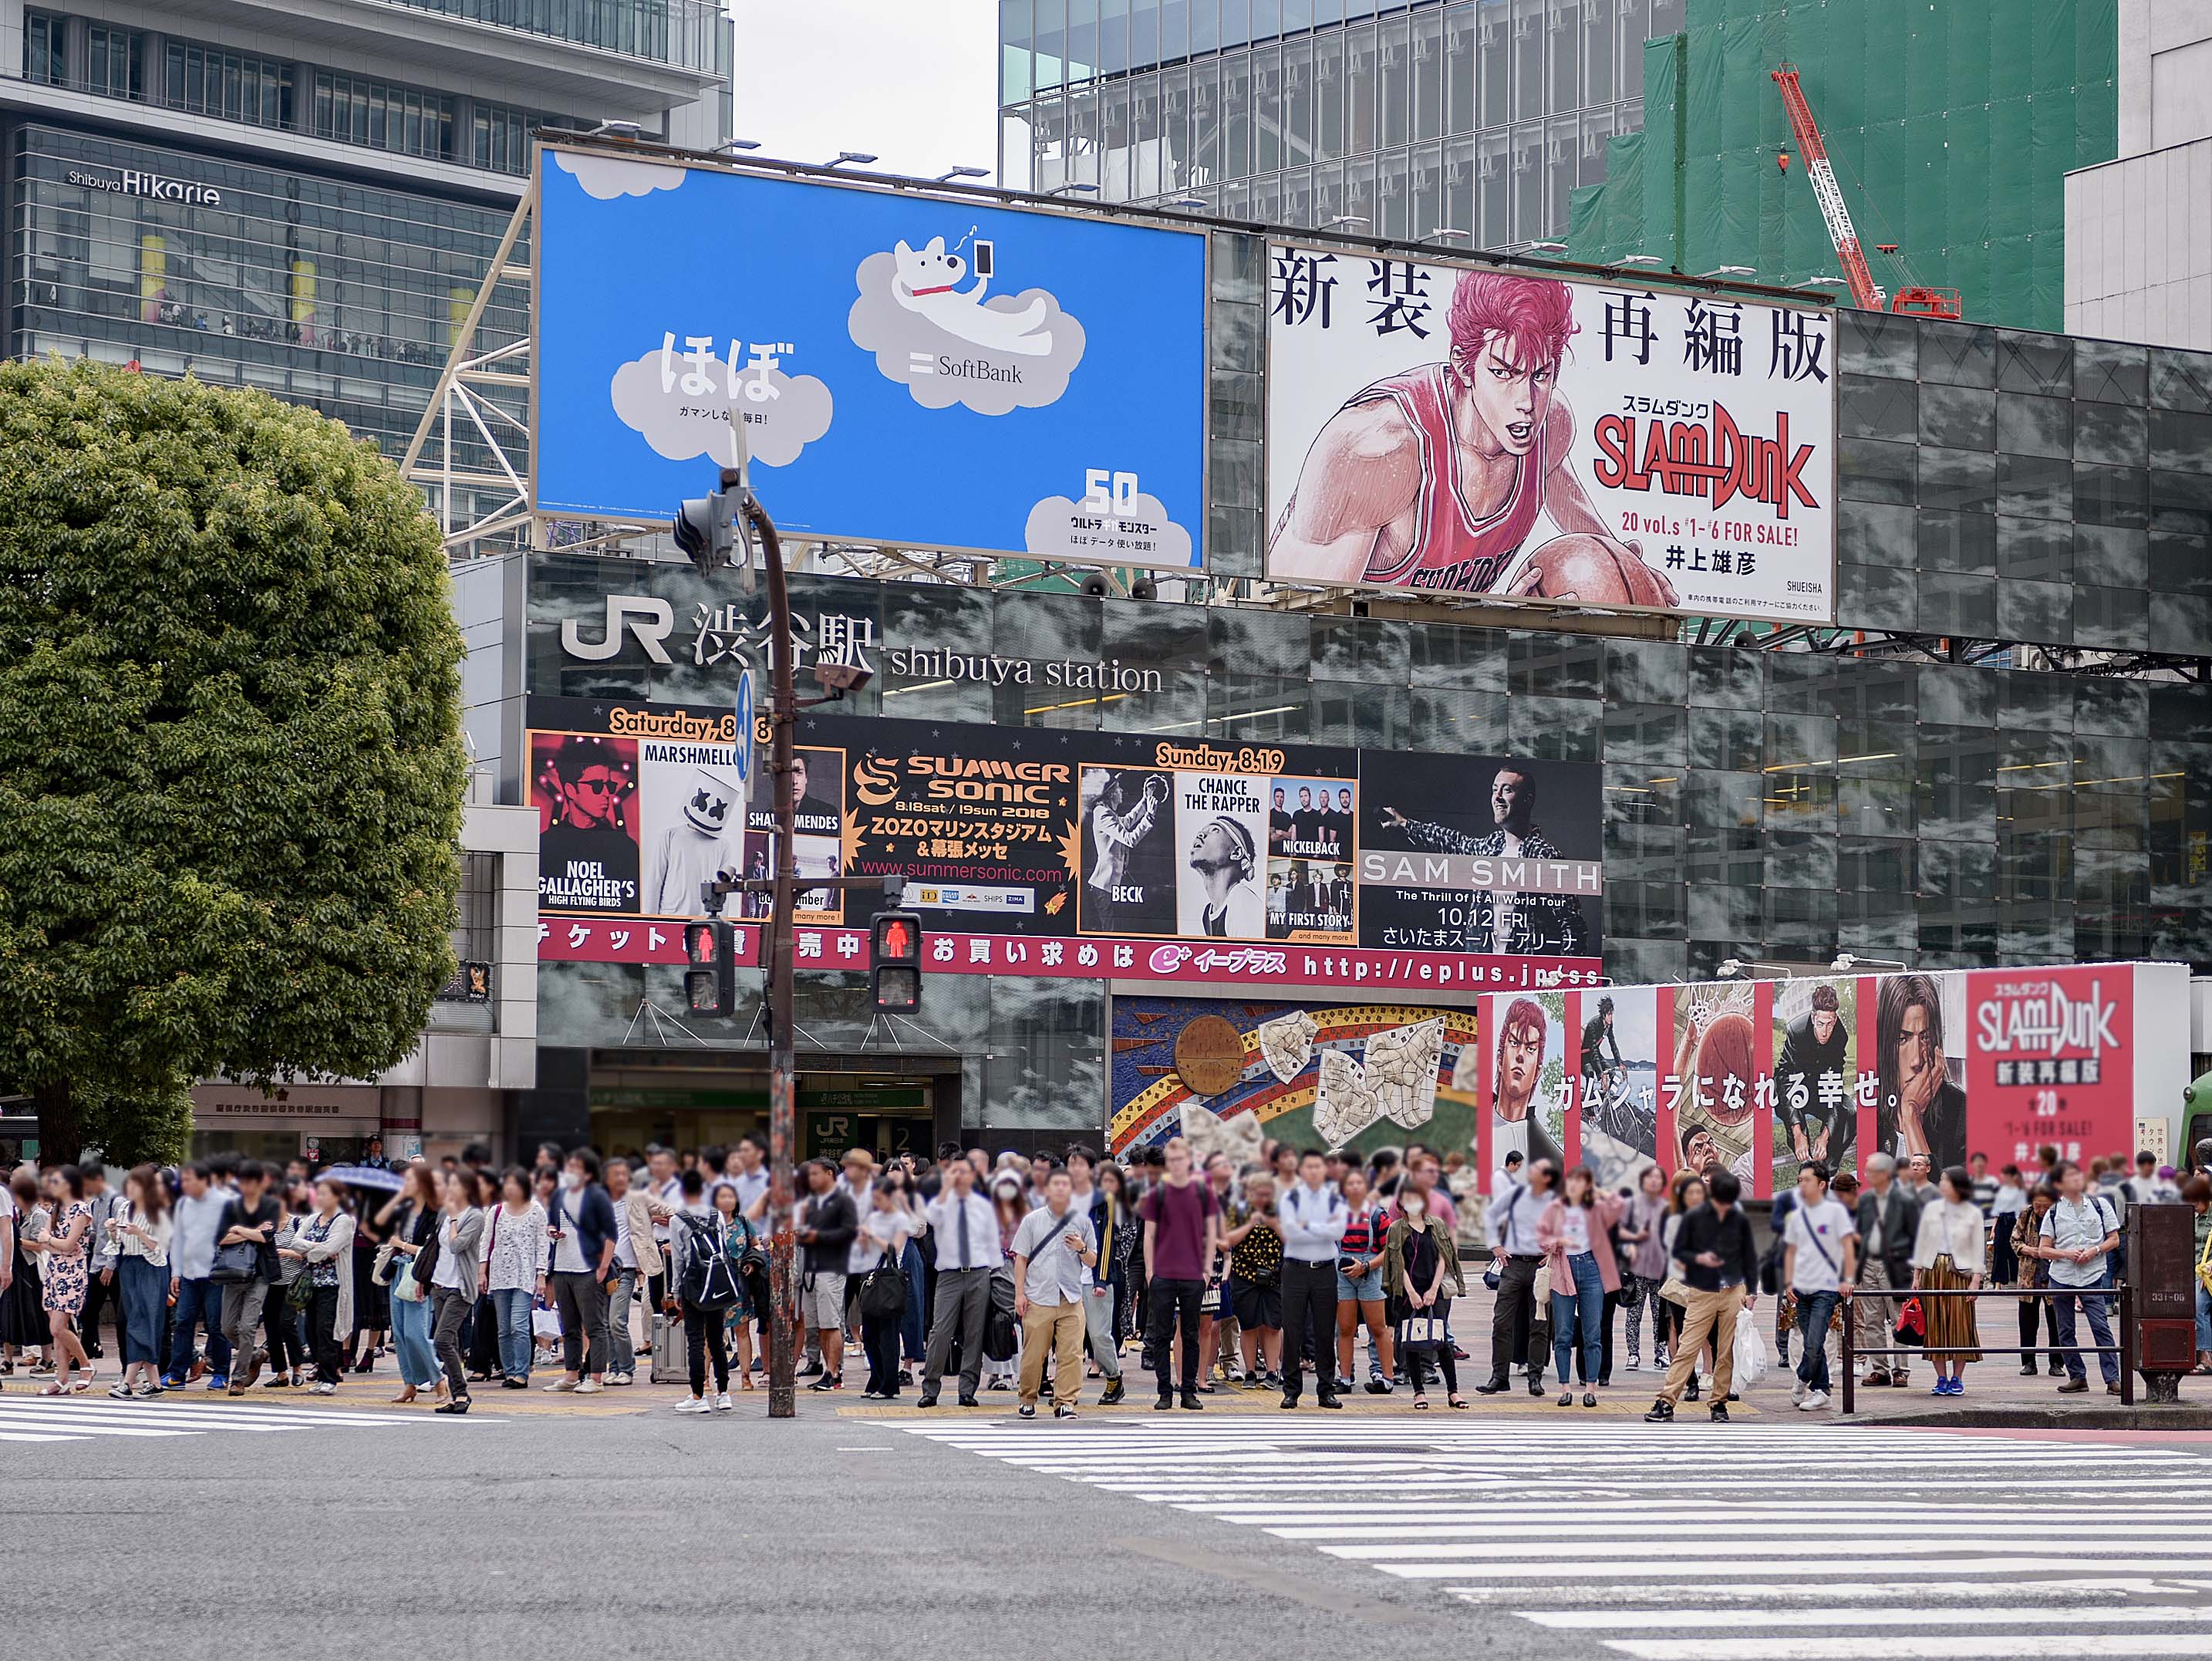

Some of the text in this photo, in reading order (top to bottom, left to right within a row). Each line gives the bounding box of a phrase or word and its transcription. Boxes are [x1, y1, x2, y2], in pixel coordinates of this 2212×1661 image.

[69, 170, 221, 205] Shibuya Hikarie
[1271, 247, 1829, 383] 新装 再編版
[661, 331, 794, 402] ほぼ
[939, 356, 1023, 383] SoftBank
[679, 406, 767, 425] ガマンしな毎日!
[1623, 395, 1709, 419] スラムダンク
[1086, 468, 1138, 517] 50
[1622, 511, 1638, 532] 20
[1643, 515, 1680, 535] vol.s
[1725, 522, 1752, 542] FOR
[1757, 524, 1799, 546] SALE!
[1666, 544, 1756, 576] 井上雄彦
[1787, 580, 1823, 594] SHUEISHA
[561, 594, 674, 664] JR
[891, 645, 1164, 694] shibuya station
[613, 710, 715, 741] Saturday,
[908, 756, 1071, 783] SUMMER
[1158, 745, 1283, 771] Sunday, 8.19
[928, 780, 1050, 804] SONIC
[1199, 778, 1247, 795] CHANCE
[895, 801, 946, 813] 8.18sat
[959, 805, 997, 816] 19sun
[1002, 808, 1050, 819] 2018
[1185, 794, 1260, 813] THE RAPPER
[749, 812, 838, 830] SHA MENDES
[872, 817, 1052, 843] ZOZOマリンスタジアム
[1283, 840, 1340, 856] NICKELBACK
[567, 860, 605, 879] NOEL
[862, 861, 1062, 883] www.summersonic.com
[1363, 855, 1597, 890] SAM SMITH
[538, 876, 635, 899] GALLAGHER'S
[1111, 886, 1144, 903] BECK
[1396, 891, 1566, 907] The Thrill Of It All World Tour
[548, 895, 622, 907] HIGH FLYING BIRDS
[1270, 912, 1350, 927] MY FIRST STORY
[1437, 907, 1528, 929] 10.12 FRI
[1383, 926, 1577, 951] さいたまスーパーアリーナ
[932, 937, 1135, 969] お買い求めは
[1195, 950, 1286, 975] イープラス
[1553, 1069, 1898, 1111] ガムシャラになれる幸せ。
[815, 1116, 849, 1137] JR
[896, 1126, 910, 1151] 2
[2152, 1292, 2185, 1301] 331-06
